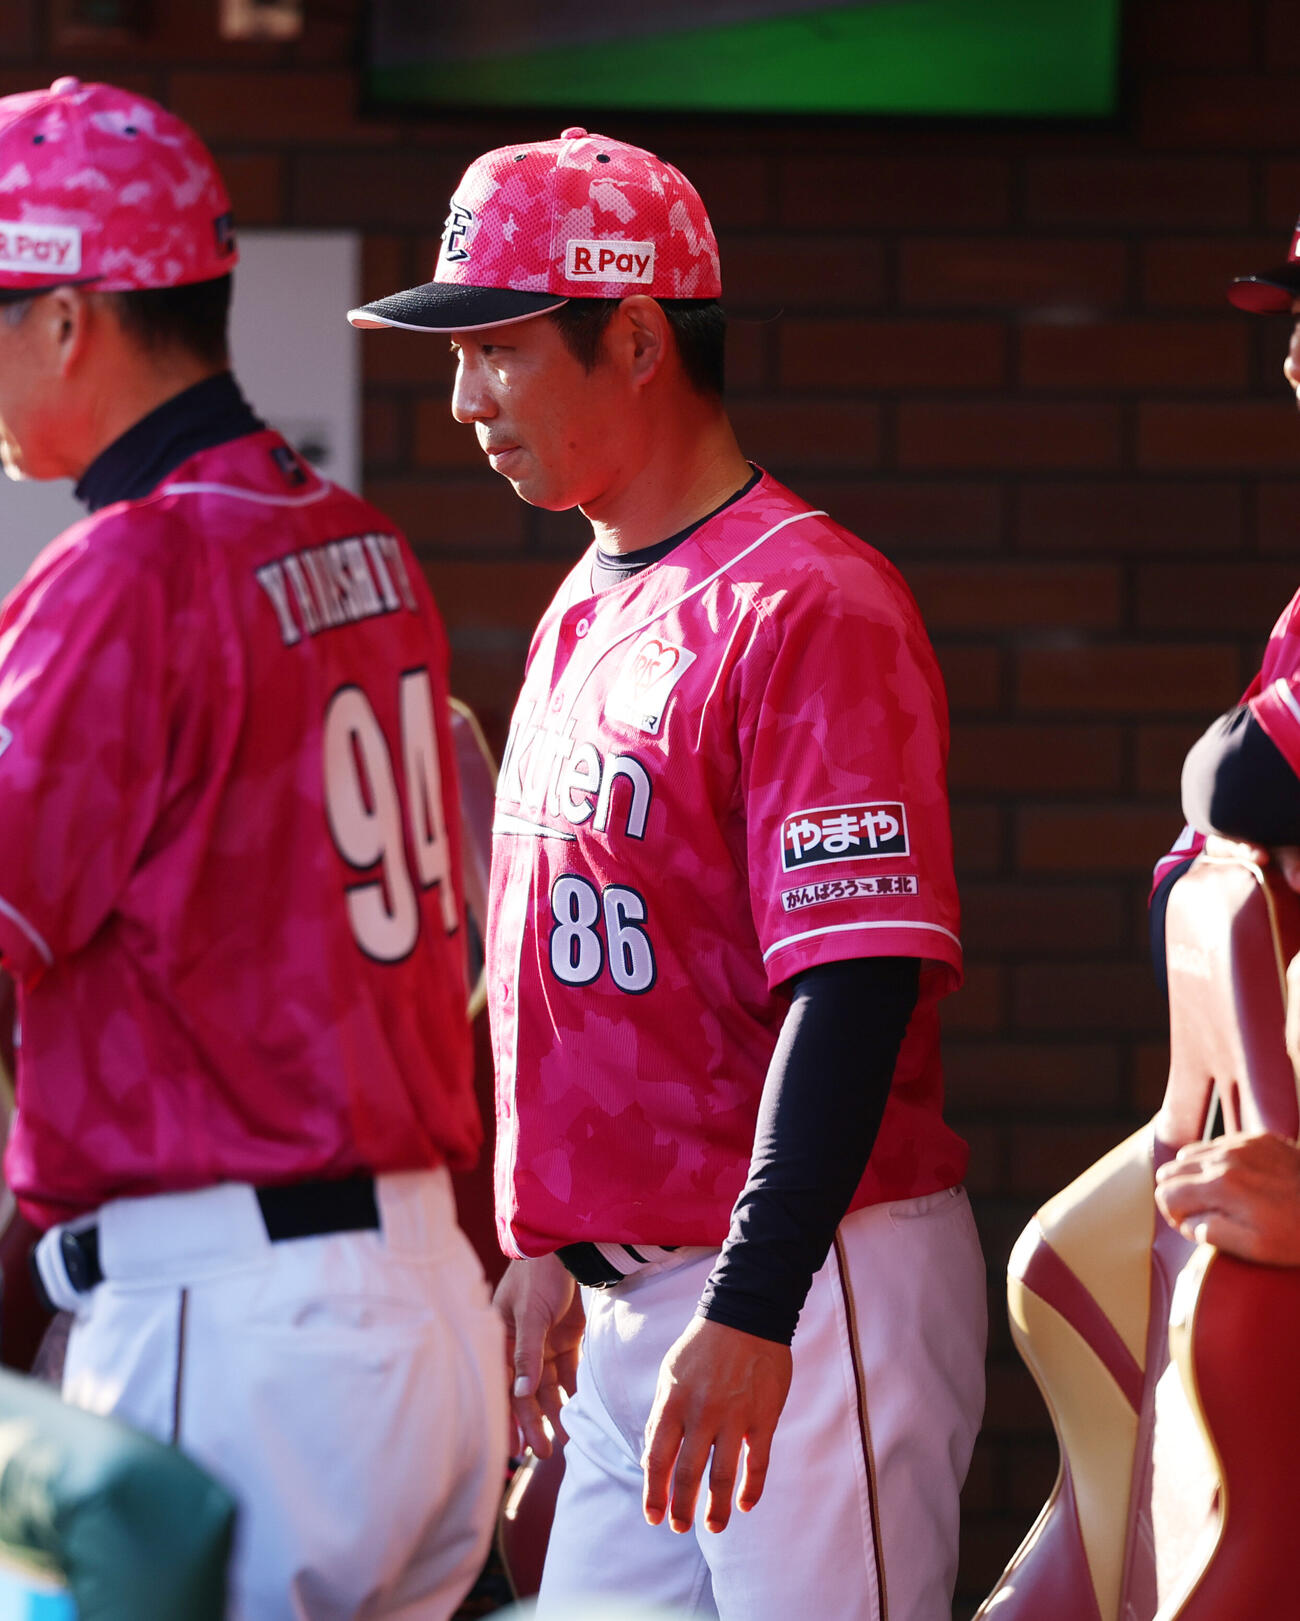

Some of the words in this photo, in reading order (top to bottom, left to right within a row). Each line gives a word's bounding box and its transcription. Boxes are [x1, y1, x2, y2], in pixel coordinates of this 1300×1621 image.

[16, 235, 72, 266] Pay
[599, 249, 651, 277] Pay
[323, 664, 458, 964] 94
[786, 810, 899, 859] やまや
[549, 873, 657, 995] 86
